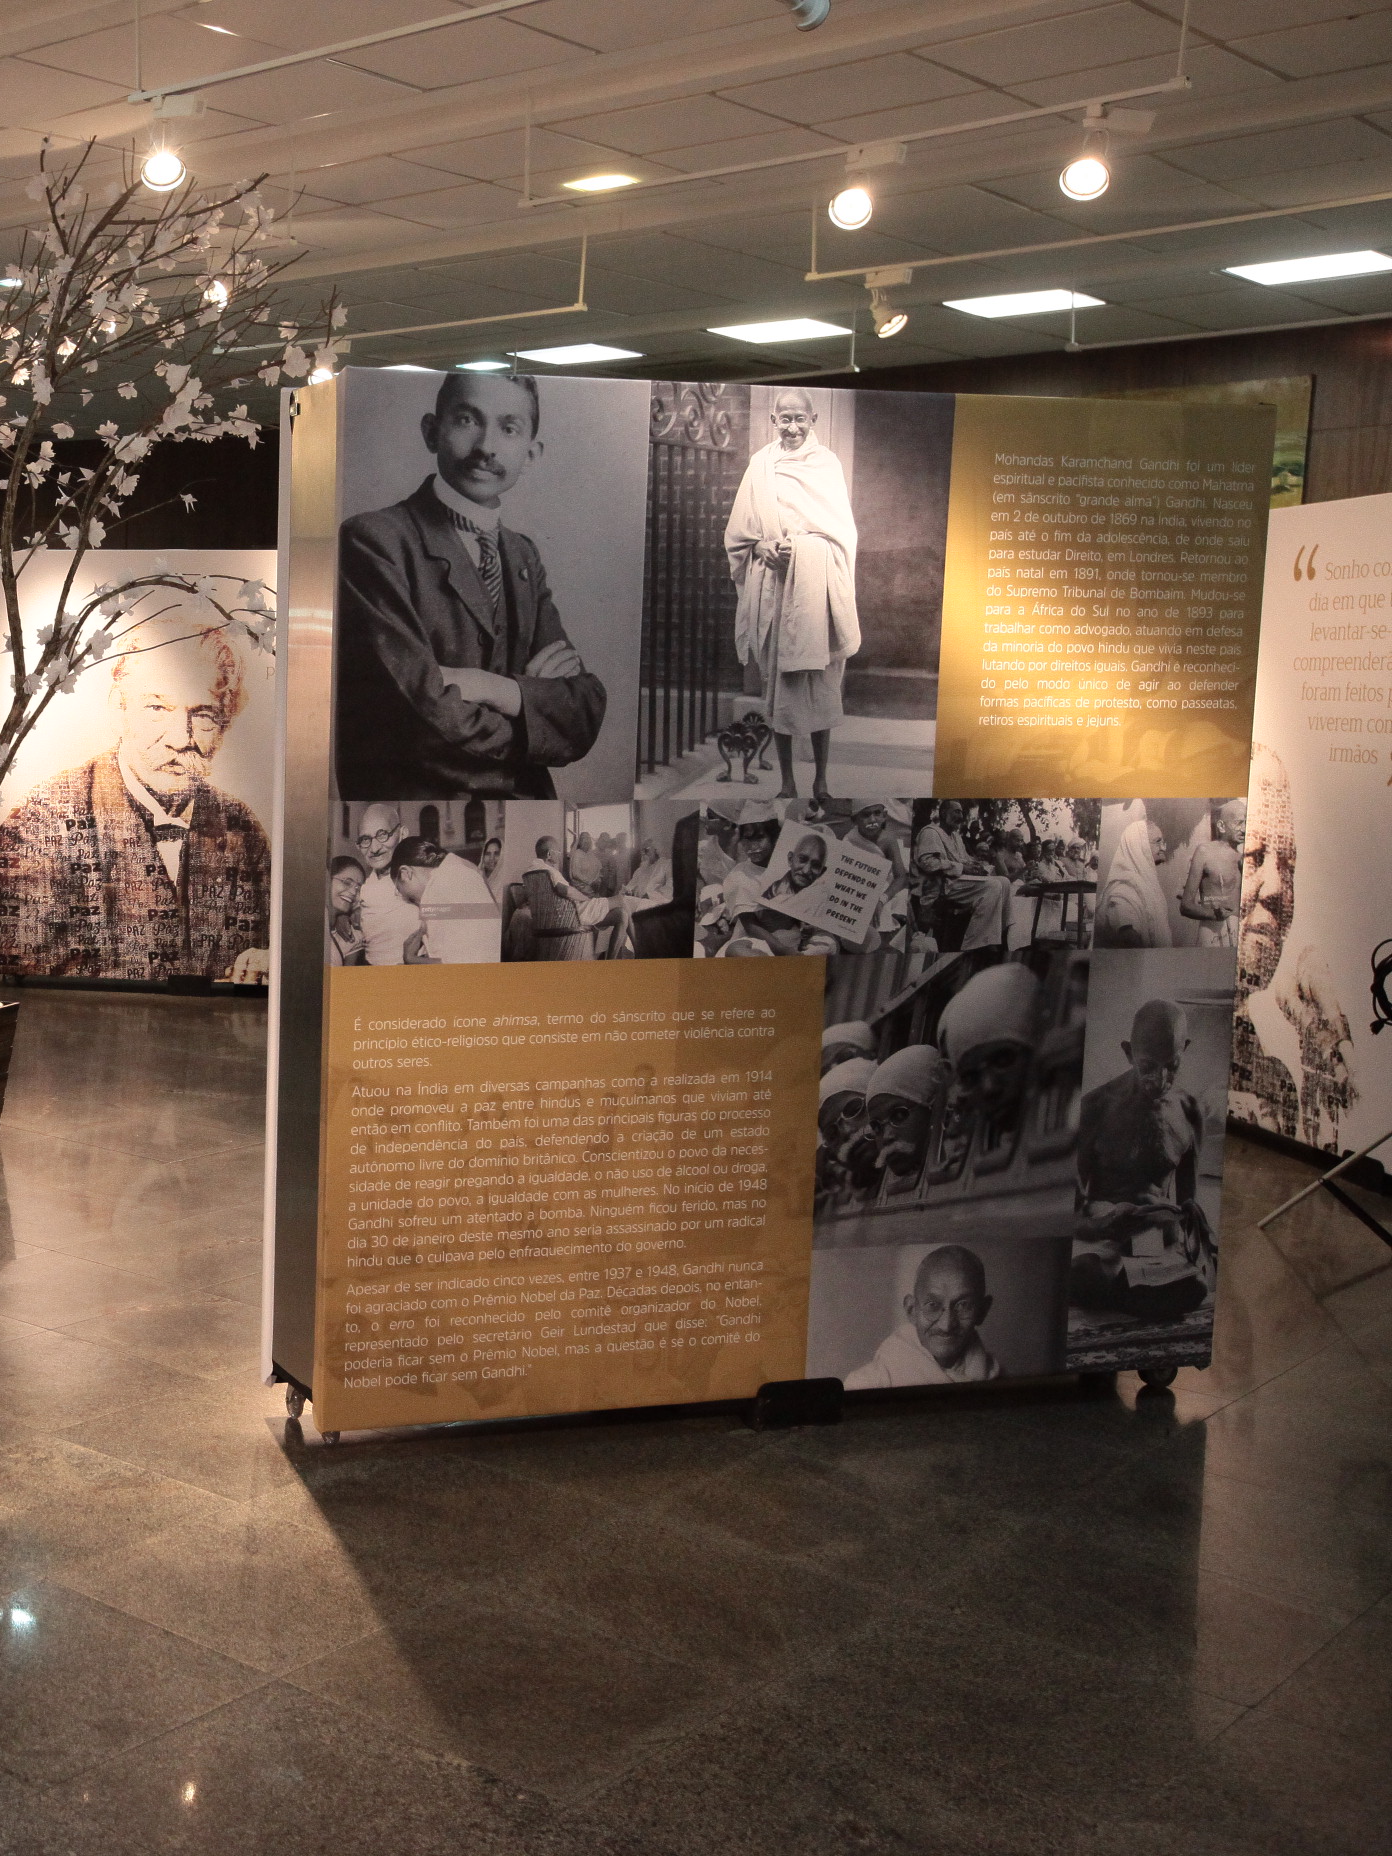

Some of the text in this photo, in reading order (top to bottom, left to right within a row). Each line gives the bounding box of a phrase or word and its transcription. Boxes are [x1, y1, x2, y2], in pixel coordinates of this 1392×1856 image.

[994, 452, 1256, 474] Mohandas Karamchand Gandhi foi um líder
[987, 565, 1011, 579] país
[1016, 566, 1045, 579] natal
[1049, 569, 1068, 579] em
[1106, 568, 1136, 581] onde
[1141, 569, 1195, 582] tornou-se
[1199, 571, 1248, 583] membro
[1325, 560, 1369, 580] Sonho
[986, 584, 1002, 597] do
[1006, 584, 1058, 598] Supremo
[1063, 585, 1107, 599] Tribunal
[1110, 587, 1126, 599] de
[1190, 588, 1246, 602] Mudou-se
[1310, 592, 1386, 614] dia em que
[981, 658, 1026, 671] lutando
[1028, 661, 1048, 673] por
[1050, 659, 1092, 672] direitos
[1130, 659, 1171, 673] Gandhi
[1173, 661, 1181, 673] é
[1182, 662, 1240, 674] reconheci-
[1301, 681, 1384, 702] foram feitos
[979, 695, 1019, 708] formas
[1023, 695, 1072, 709] pacíficas
[1074, 696, 1090, 709] de
[1146, 698, 1178, 709] como
[978, 714, 1014, 726] retiros
[1016, 714, 1073, 728] espirituais
[1076, 716, 1084, 727] e
[1308, 712, 1363, 732] viverem
[1328, 744, 1378, 764] irmãos
[45, 835, 63, 847] PAZ
[123, 838, 142, 848] PAZ
[70, 862, 103, 875] Paz
[841, 855, 881, 876] THE FUTURE
[125, 880, 144, 893] PAZ
[834, 868, 878, 889] DEPENDS ON
[835, 882, 868, 900] WHAT WE
[69, 905, 101, 918] Paz
[829, 895, 840, 904] DO
[849, 903, 864, 914] THE
[148, 908, 179, 921] Paz
[826, 909, 857, 926] PRESENT
[127, 925, 145, 936] PAZ
[127, 967, 145, 979] PAZ
[354, 1007, 776, 1032] É considerado ícone ahimsa, termo do sânscrito que se refere ao
[351, 1069, 773, 1098] Atuou na Índia em diversas campanhas como a realizada em 1914
[350, 1108, 772, 1137] então em conflito. Também foi uma das principais figuras do processo
[347, 1214, 766, 1250] dia 30 de janeiro deste mesmo ano seria assassinado por um radical
[345, 1278, 763, 1315] foi agraciado com o Prêmio Nobel da Paz. Décadas depois, no entan-
[343, 1363, 532, 1389] Nobel pode ficar sem Gandhi."
